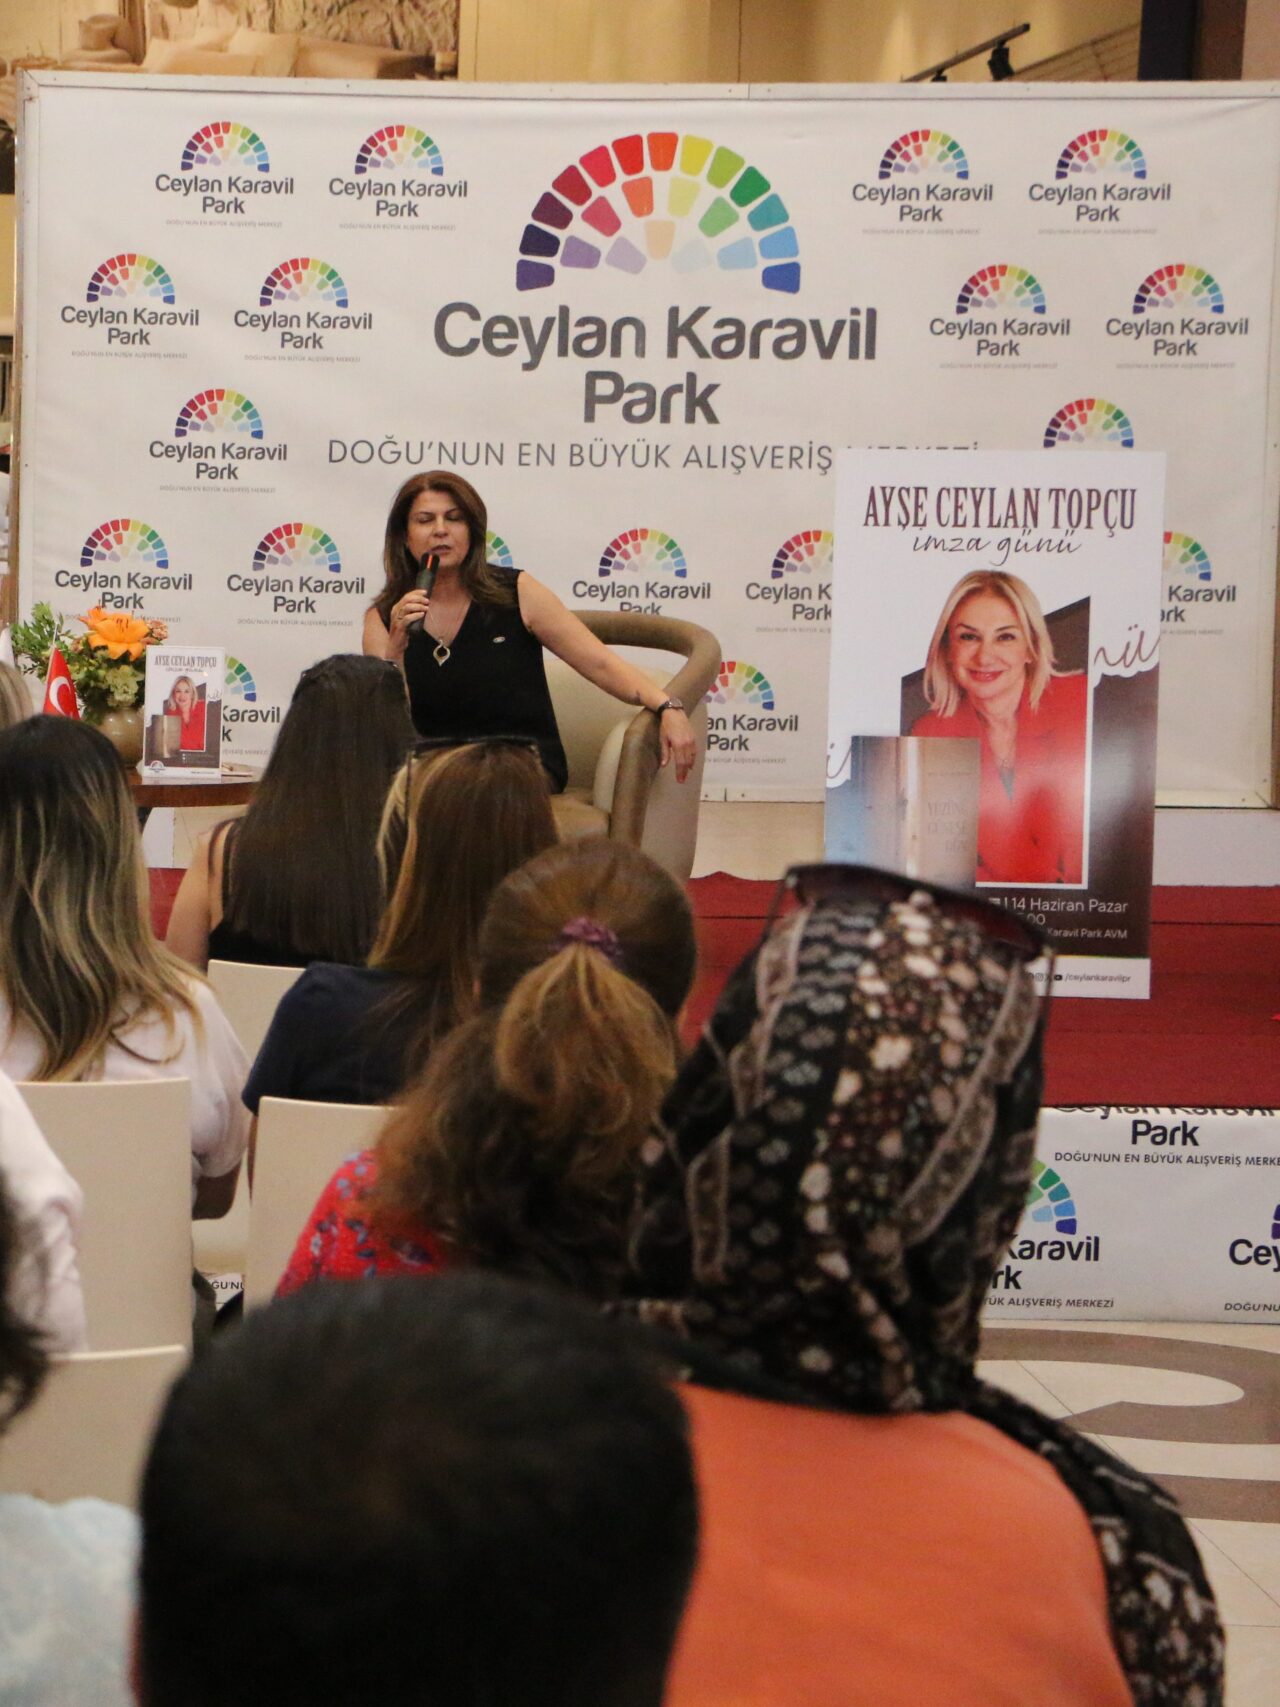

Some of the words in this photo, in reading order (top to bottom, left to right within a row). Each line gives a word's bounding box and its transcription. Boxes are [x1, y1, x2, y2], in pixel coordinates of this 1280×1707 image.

[155, 174, 222, 196] Ceylan
[228, 176, 294, 194] Karavil
[329, 178, 396, 200] Ceylan
[402, 179, 468, 197] Karavil
[852, 183, 920, 206] Ceylan
[926, 184, 993, 201] Karavil
[1028, 183, 1097, 205] Ceylan
[1103, 183, 1171, 201] Karavil
[202, 196, 245, 214] Park
[376, 200, 419, 217] Park
[899, 205, 943, 222] Park
[1076, 205, 1120, 222] Park
[61, 305, 127, 328] Ceylan
[133, 307, 200, 326] Karavil
[234, 310, 301, 332] Ceylan
[307, 311, 372, 330] Karavil
[108, 327, 151, 345] Park
[434, 302, 646, 371] Ceylan
[666, 305, 877, 360] Karavil
[929, 318, 997, 340] Ceylan
[1003, 318, 1070, 336] Karavil
[1106, 318, 1174, 340] Ceylan
[1181, 318, 1249, 335] Karavil
[281, 332, 324, 349] Park
[977, 339, 1020, 356] Park
[1154, 339, 1197, 356] Park
[584, 370, 721, 425] Park
[149, 441, 216, 462] Ceylan
[222, 442, 287, 461] Karavil
[328, 435, 504, 465] DOĞU'NUN
[518, 443, 555, 466] EN
[569, 437, 670, 468] BÜYÜK
[682, 440, 833, 474] ALIŞVERİŞ
[196, 462, 238, 480] Park
[863, 486, 928, 531] AYŞE
[936, 487, 1041, 529] CEYLAN
[1048, 488, 1137, 537] TOPÇU
[913, 526, 990, 552] imza
[989, 530, 1082, 566] günü
[55, 570, 121, 592] Ceylan
[127, 572, 193, 590] Karavil
[227, 574, 293, 596] Ceylan
[299, 576, 365, 594] Karavil
[572, 580, 639, 602] Ceylan
[645, 582, 711, 599] Karavil
[102, 592, 144, 609] Park
[746, 582, 812, 604] Ceylan
[1168, 585, 1236, 602] Karavil
[274, 596, 316, 613] Park
[732, 714, 798, 731] Karavil
[707, 734, 749, 751] Park
[1030, 898, 1084, 912] Haziran
[1089, 899, 1128, 913] Pazar
[1081, 928, 1102, 938] Park
[1104, 929, 1128, 938] AVM
[1131, 1119, 1199, 1146] Park
[1055, 1151, 1120, 1162] DOĞU'NUN
[1125, 1154, 1139, 1163] EN
[1144, 1152, 1182, 1164] BÜYÜK
[1186, 1154, 1241, 1167] ALIŞVERİŞ
[992, 1265, 1022, 1289] rk
[1008, 1297, 1062, 1308] ALIŞVERİŞ
[1066, 1298, 1114, 1308] MERKEZİ
